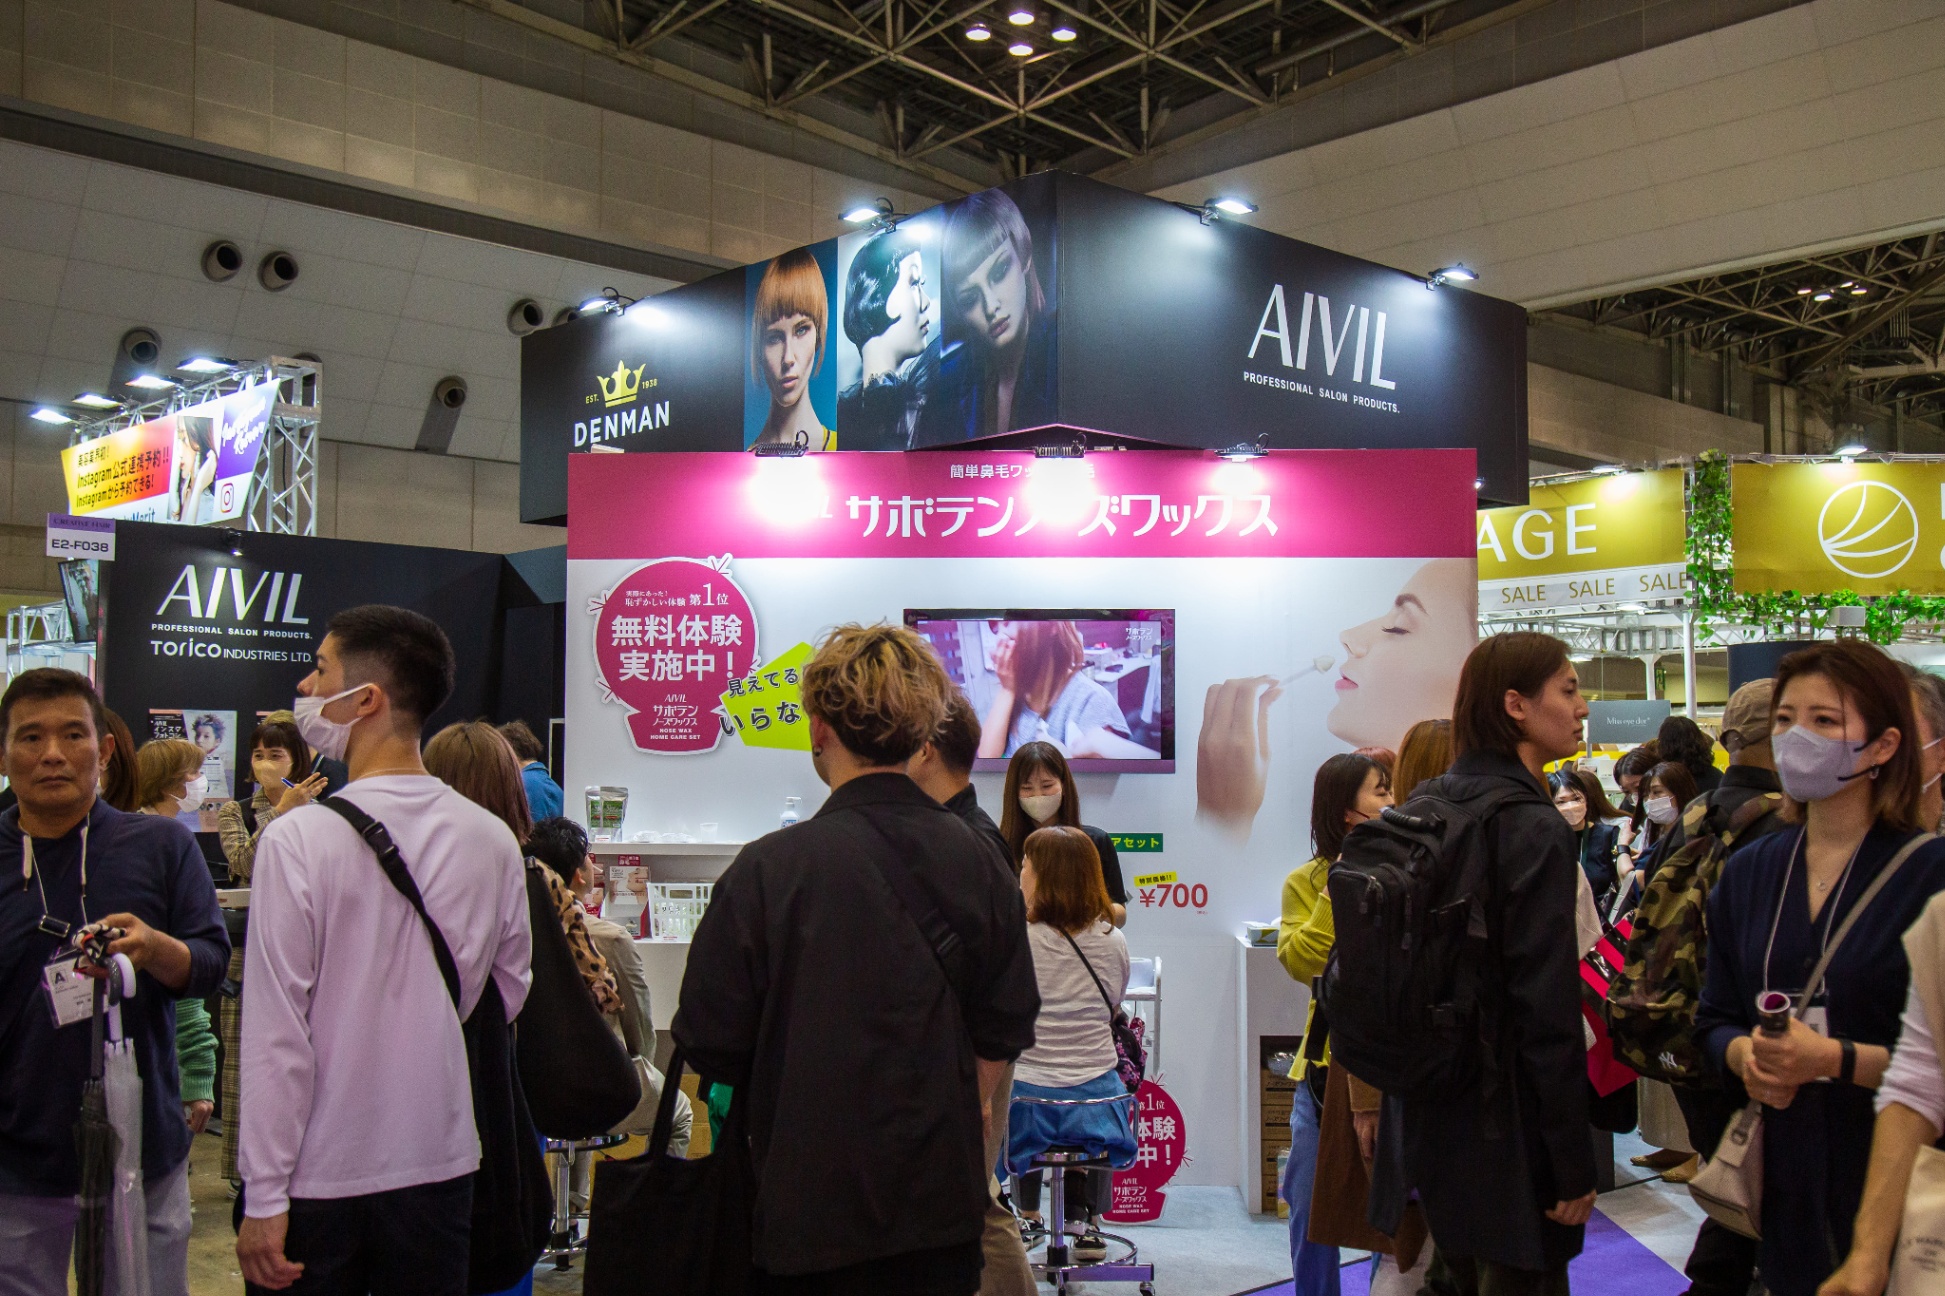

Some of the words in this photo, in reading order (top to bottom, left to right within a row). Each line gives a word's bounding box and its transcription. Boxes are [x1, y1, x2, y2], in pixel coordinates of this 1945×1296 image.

[1248, 284, 1396, 390] AIVIL
[585, 394, 599, 404] EST.
[642, 378, 658, 389] 1938
[1243, 371, 1314, 395] PROFESSIONAL
[1319, 388, 1348, 402] SALON
[574, 400, 670, 447] DENMAN
[51, 538, 109, 552] E2-F038
[156, 564, 309, 624] AIVIL
[1502, 585, 1546, 604] SALE
[1569, 578, 1615, 599] SALE
[1639, 571, 1687, 593] SALE
[151, 623, 223, 635] PROFESSIONAL
[228, 627, 259, 637] SALON
[611, 614, 743, 647] 無料体験
[223, 648, 288, 661] INDUSTRIES
[291, 652, 313, 663] LTD.
[653, 704, 699, 717] サボテン
[1139, 882, 1208, 908] ¥700
